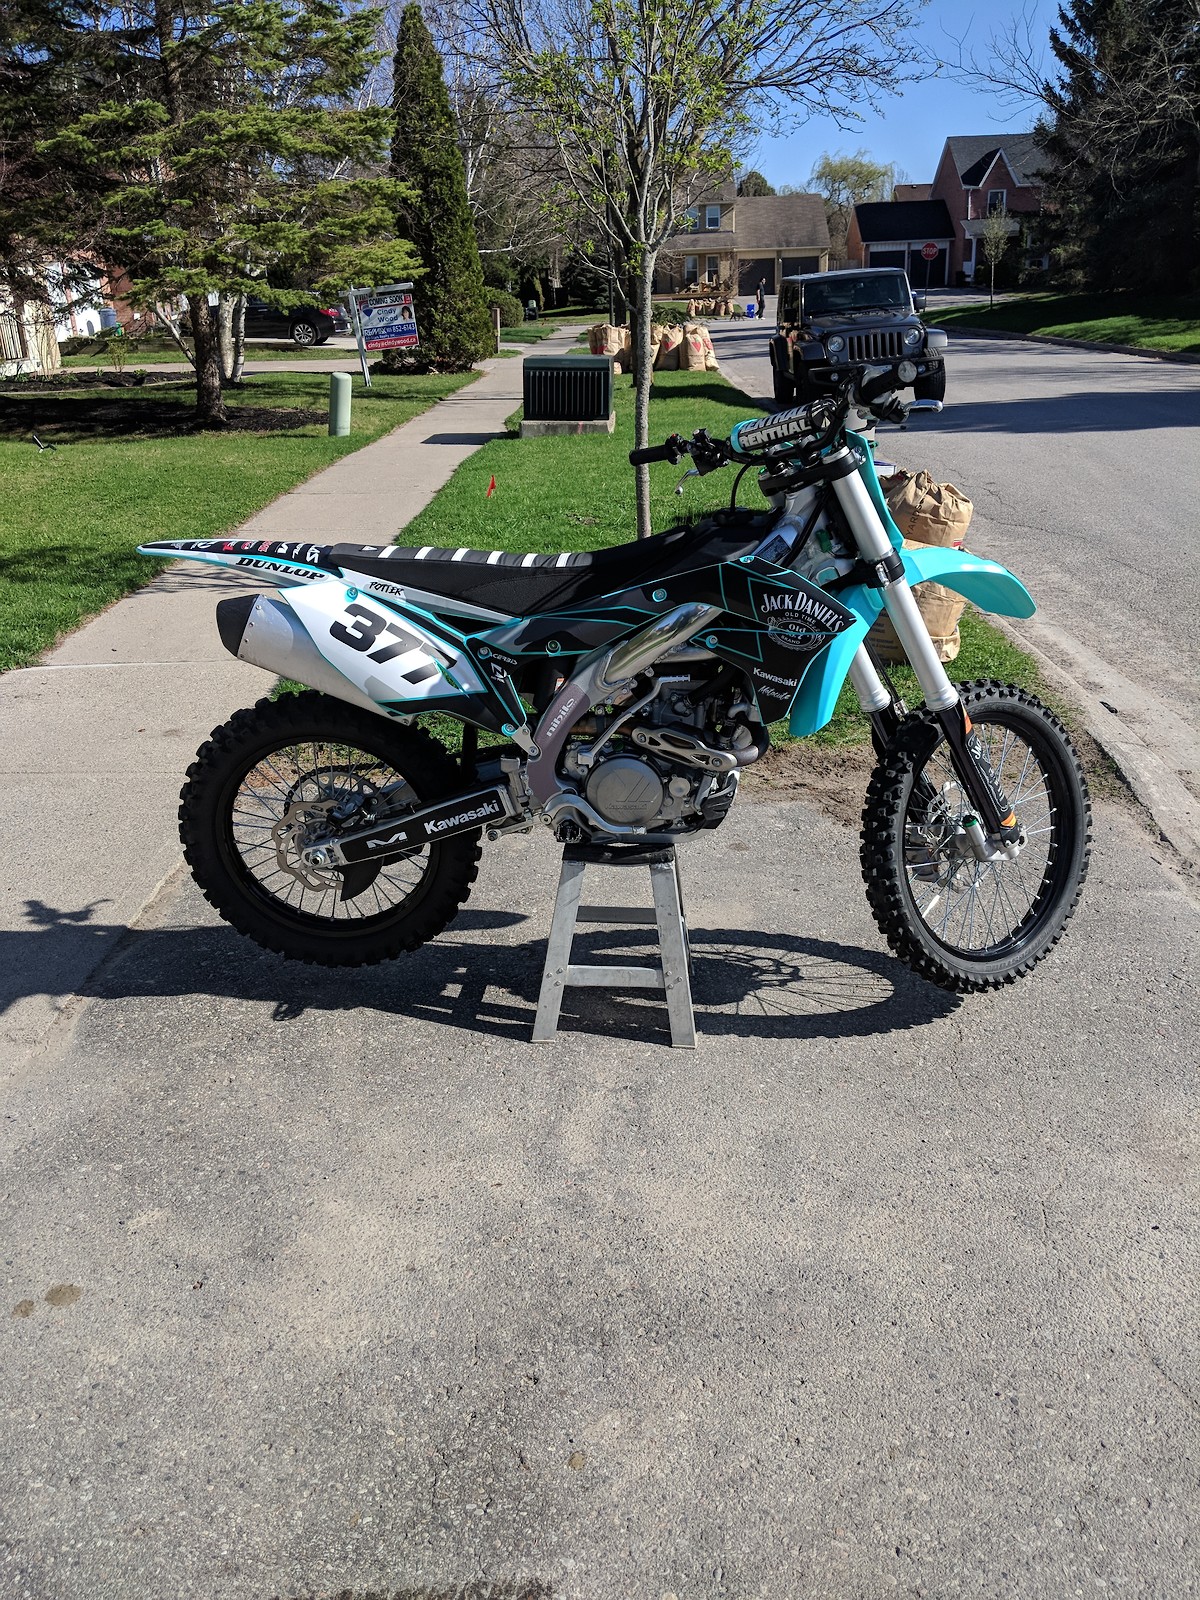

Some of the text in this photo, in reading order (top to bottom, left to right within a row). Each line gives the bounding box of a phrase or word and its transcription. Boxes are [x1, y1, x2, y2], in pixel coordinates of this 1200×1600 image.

[922, 247, 938, 255] STOP
[369, 296, 388, 306] COMING
[390, 294, 404, 303] SOON
[377, 307, 397, 316] Cindy
[377, 315, 399, 323] Wood
[739, 419, 812, 448] RENTHAL
[236, 557, 325, 579] DUNLOP
[761, 591, 844, 633] JACK DANIEL'S
[801, 614, 817, 625] TIME
[329, 603, 457, 684] 377
[753, 667, 798, 687] Kawasaki
[423, 800, 500, 835] Kawasaki
